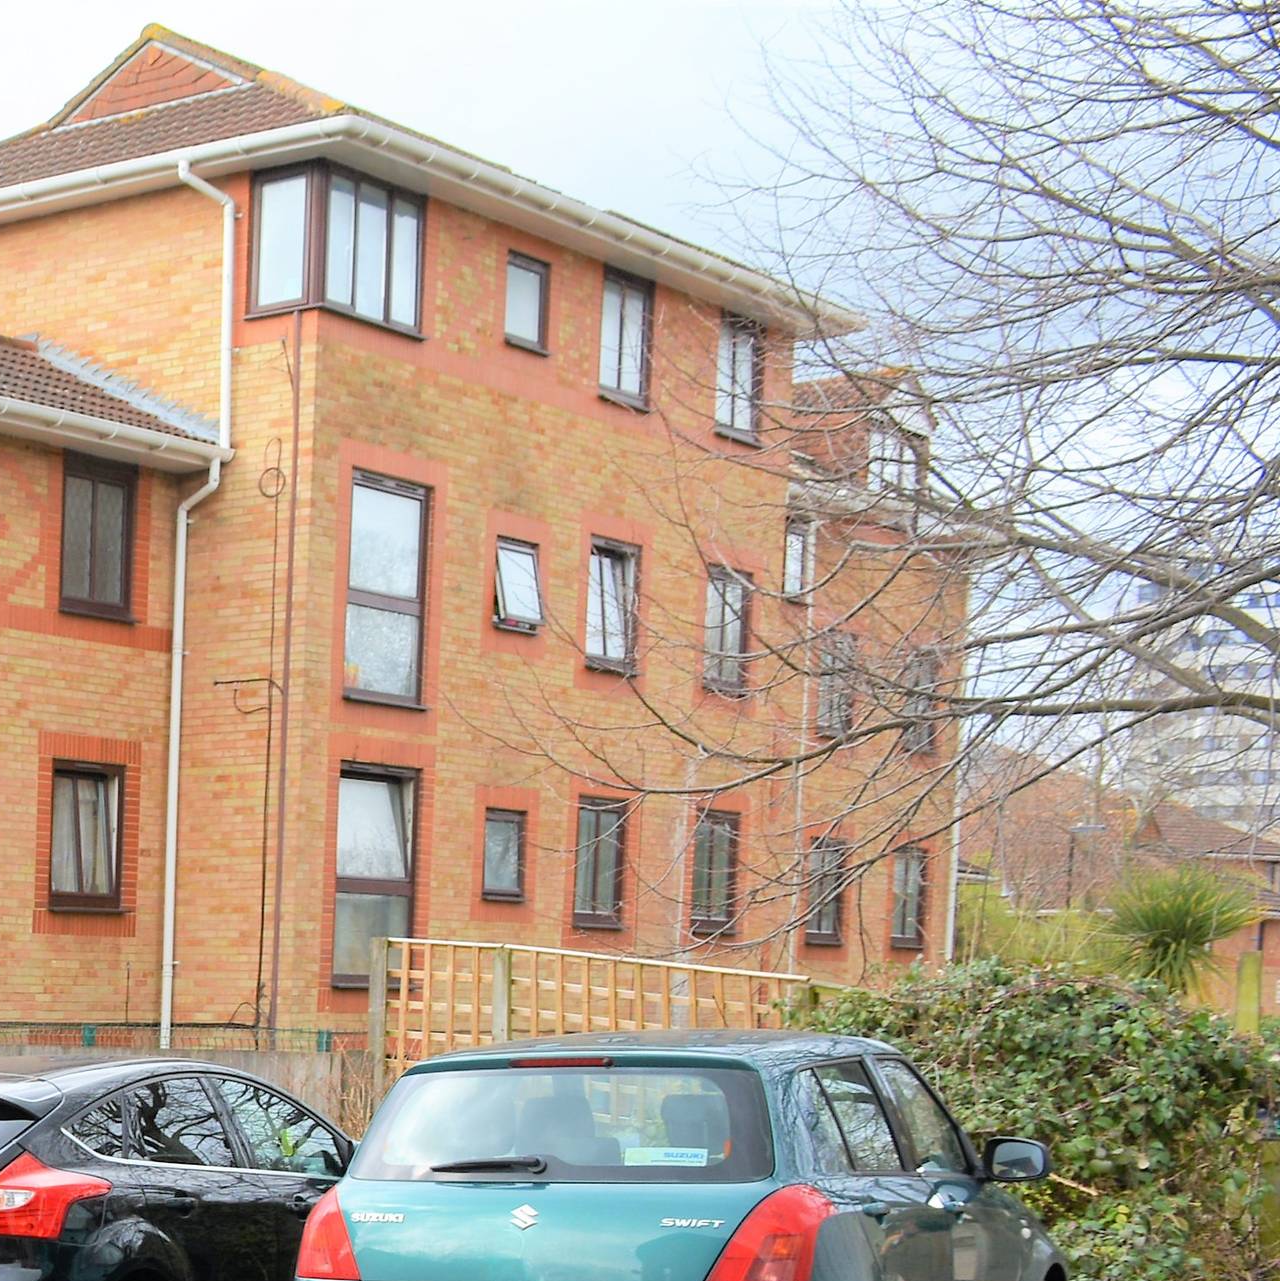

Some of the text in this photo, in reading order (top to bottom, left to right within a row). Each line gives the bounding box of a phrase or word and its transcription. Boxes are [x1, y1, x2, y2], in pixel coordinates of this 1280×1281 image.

[663, 1152, 704, 1160] SUZUKI
[351, 1211, 405, 1223] SUZUKI
[659, 1217, 726, 1229] SWIFT
